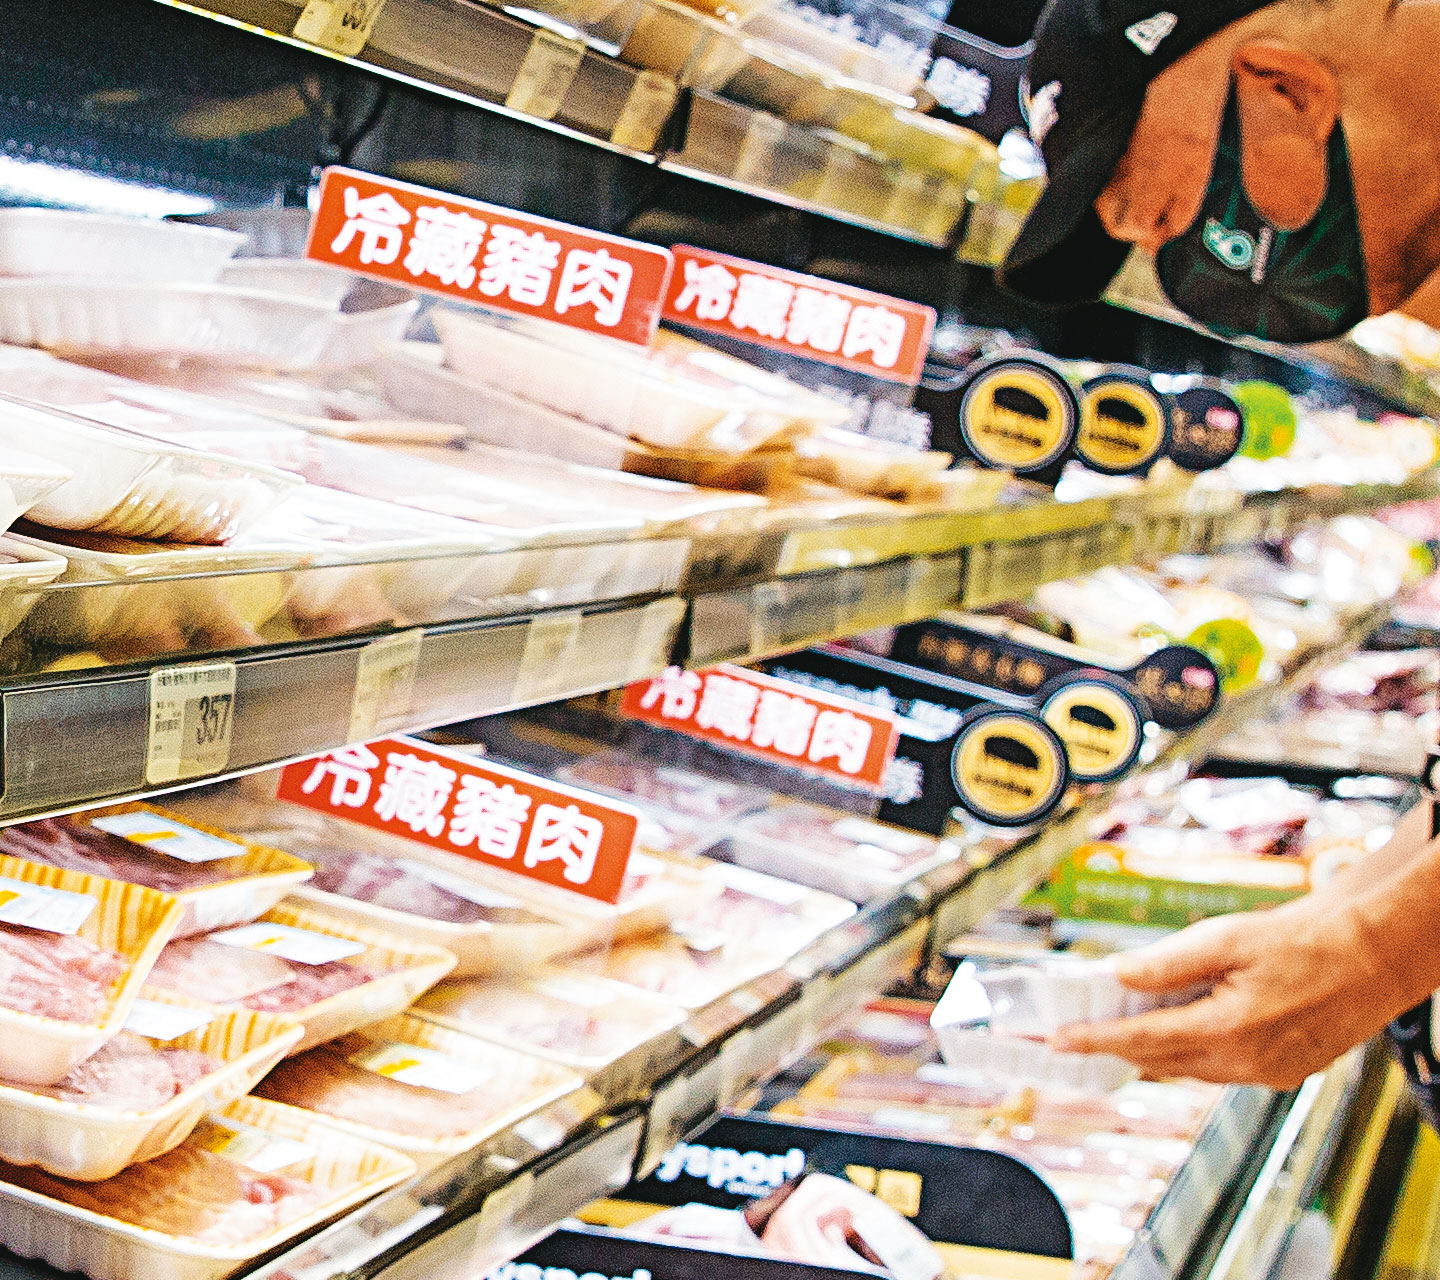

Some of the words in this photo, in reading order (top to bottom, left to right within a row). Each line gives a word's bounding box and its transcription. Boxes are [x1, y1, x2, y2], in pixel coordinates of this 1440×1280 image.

[330, 184, 633, 325] 冷藏豬肉
[673, 259, 904, 366] 冷藏豬肉
[637, 668, 872, 775] 冷藏豬肉
[306, 749, 603, 884] 冷藏豬肉
